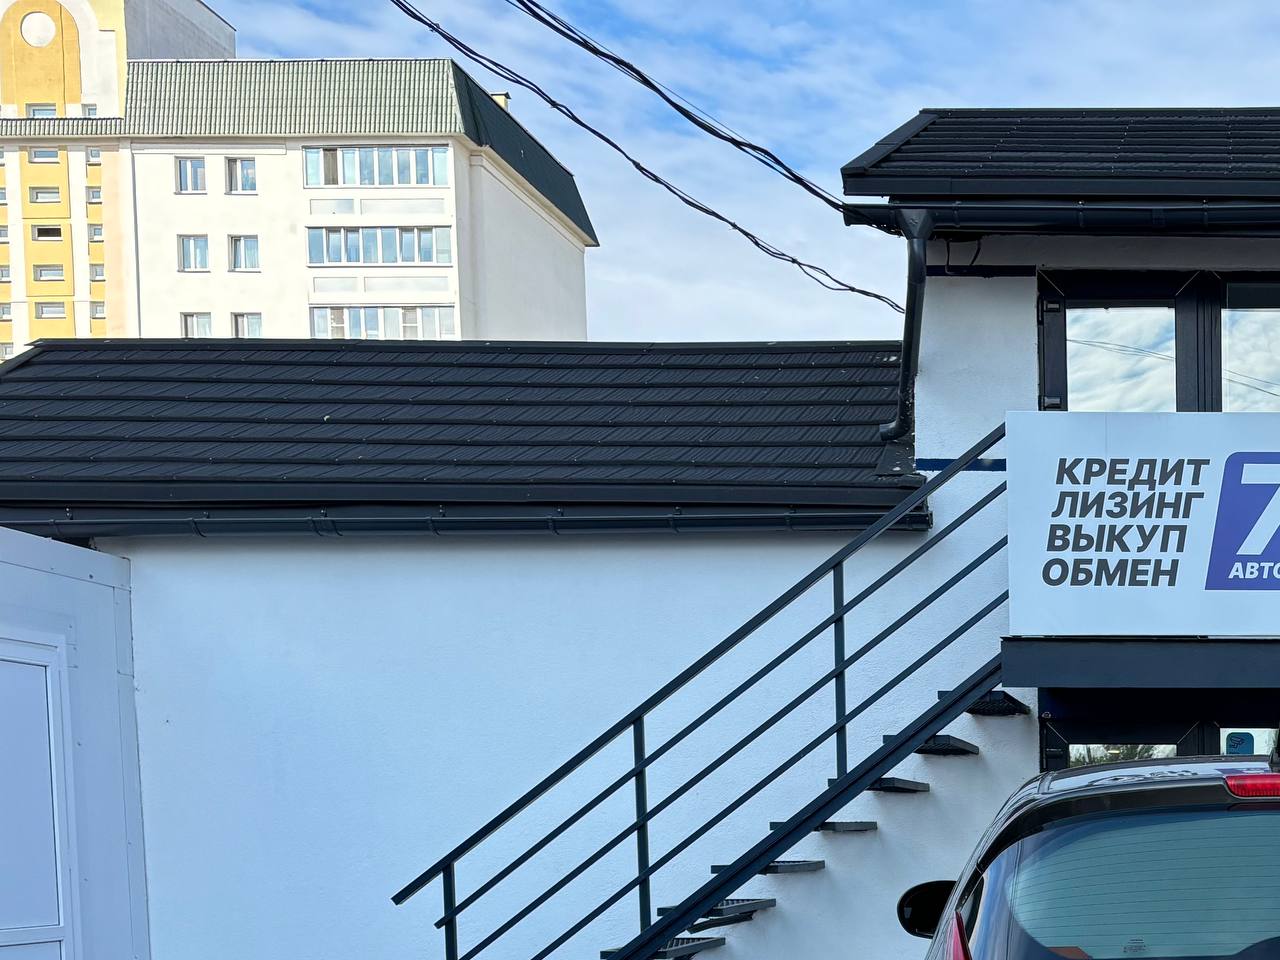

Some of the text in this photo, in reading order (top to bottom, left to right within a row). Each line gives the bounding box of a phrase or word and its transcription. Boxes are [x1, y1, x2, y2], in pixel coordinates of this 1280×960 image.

[1055, 457, 1211, 491] КРЕДИТ
[1051, 490, 1205, 519] ЛИЗИНГ
[1046, 523, 1188, 553] ВЫКУП
[1041, 557, 1180, 587] ОБМЕН
